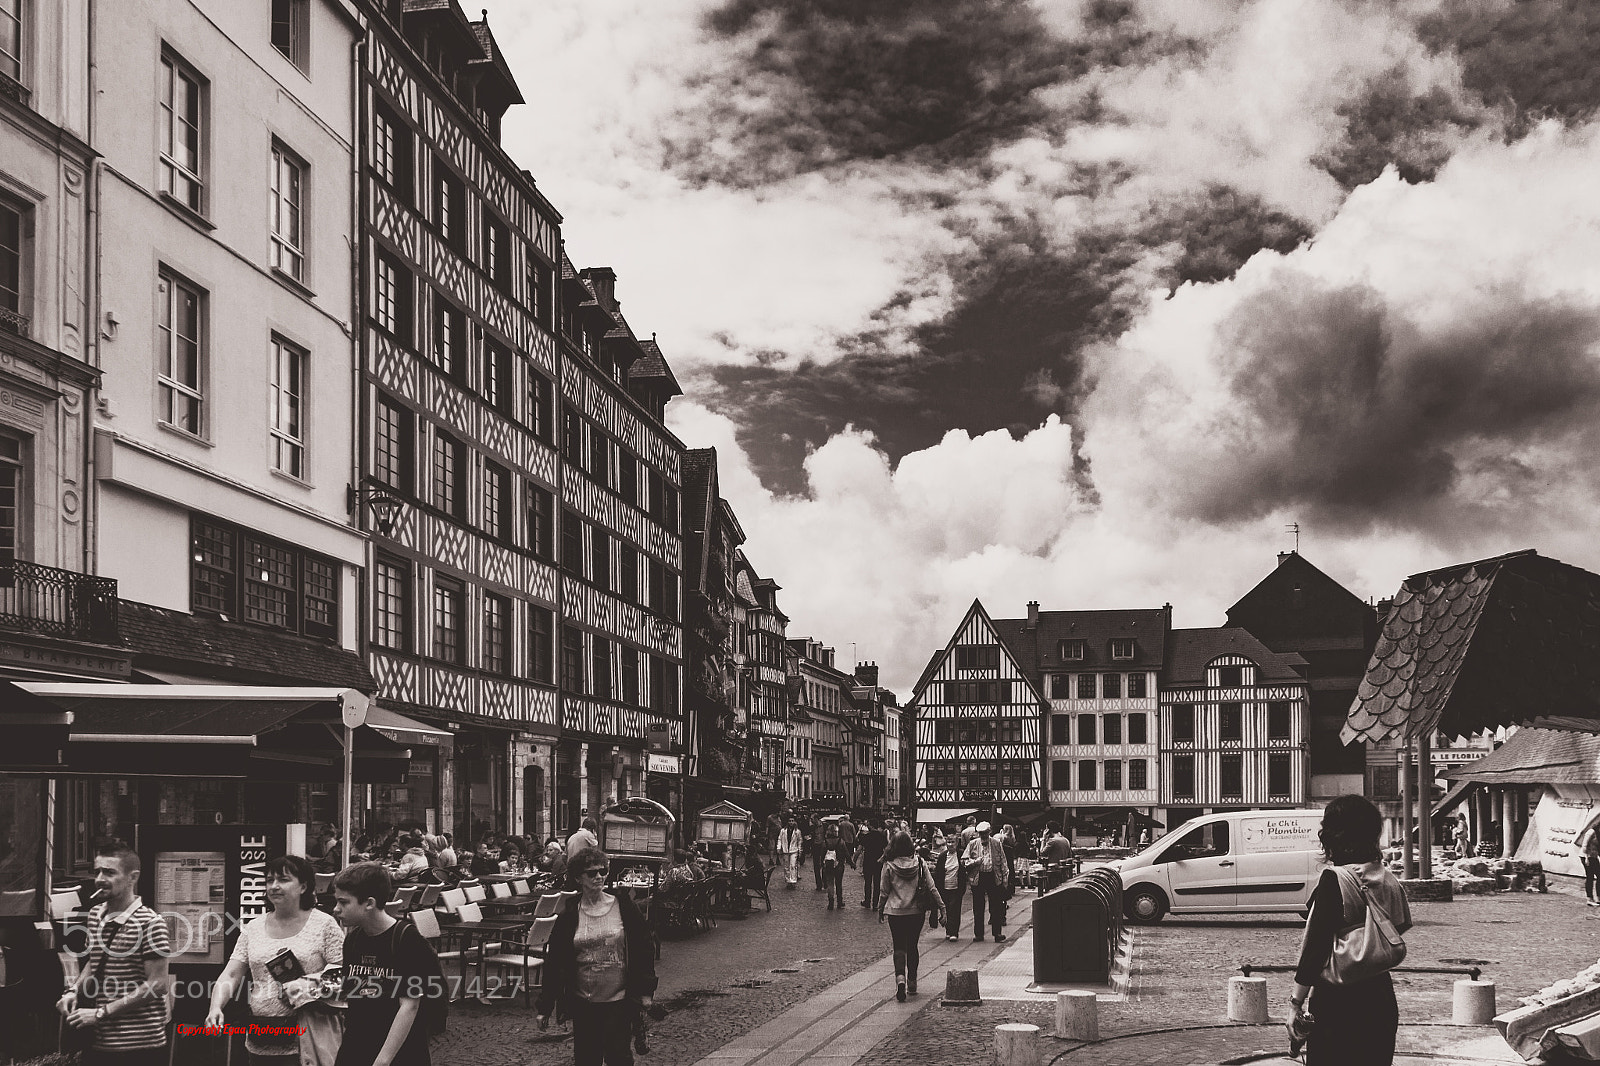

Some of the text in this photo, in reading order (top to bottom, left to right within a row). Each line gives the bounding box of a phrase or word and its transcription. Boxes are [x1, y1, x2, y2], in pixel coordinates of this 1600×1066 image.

[23, 648, 124, 672] BRASSERIE
[651, 763, 677, 772] SOUVENIRS
[1267, 820, 1277, 828] Le
[1267, 827, 1312, 835] Plombier
[240, 835, 267, 926] ERRASSE
